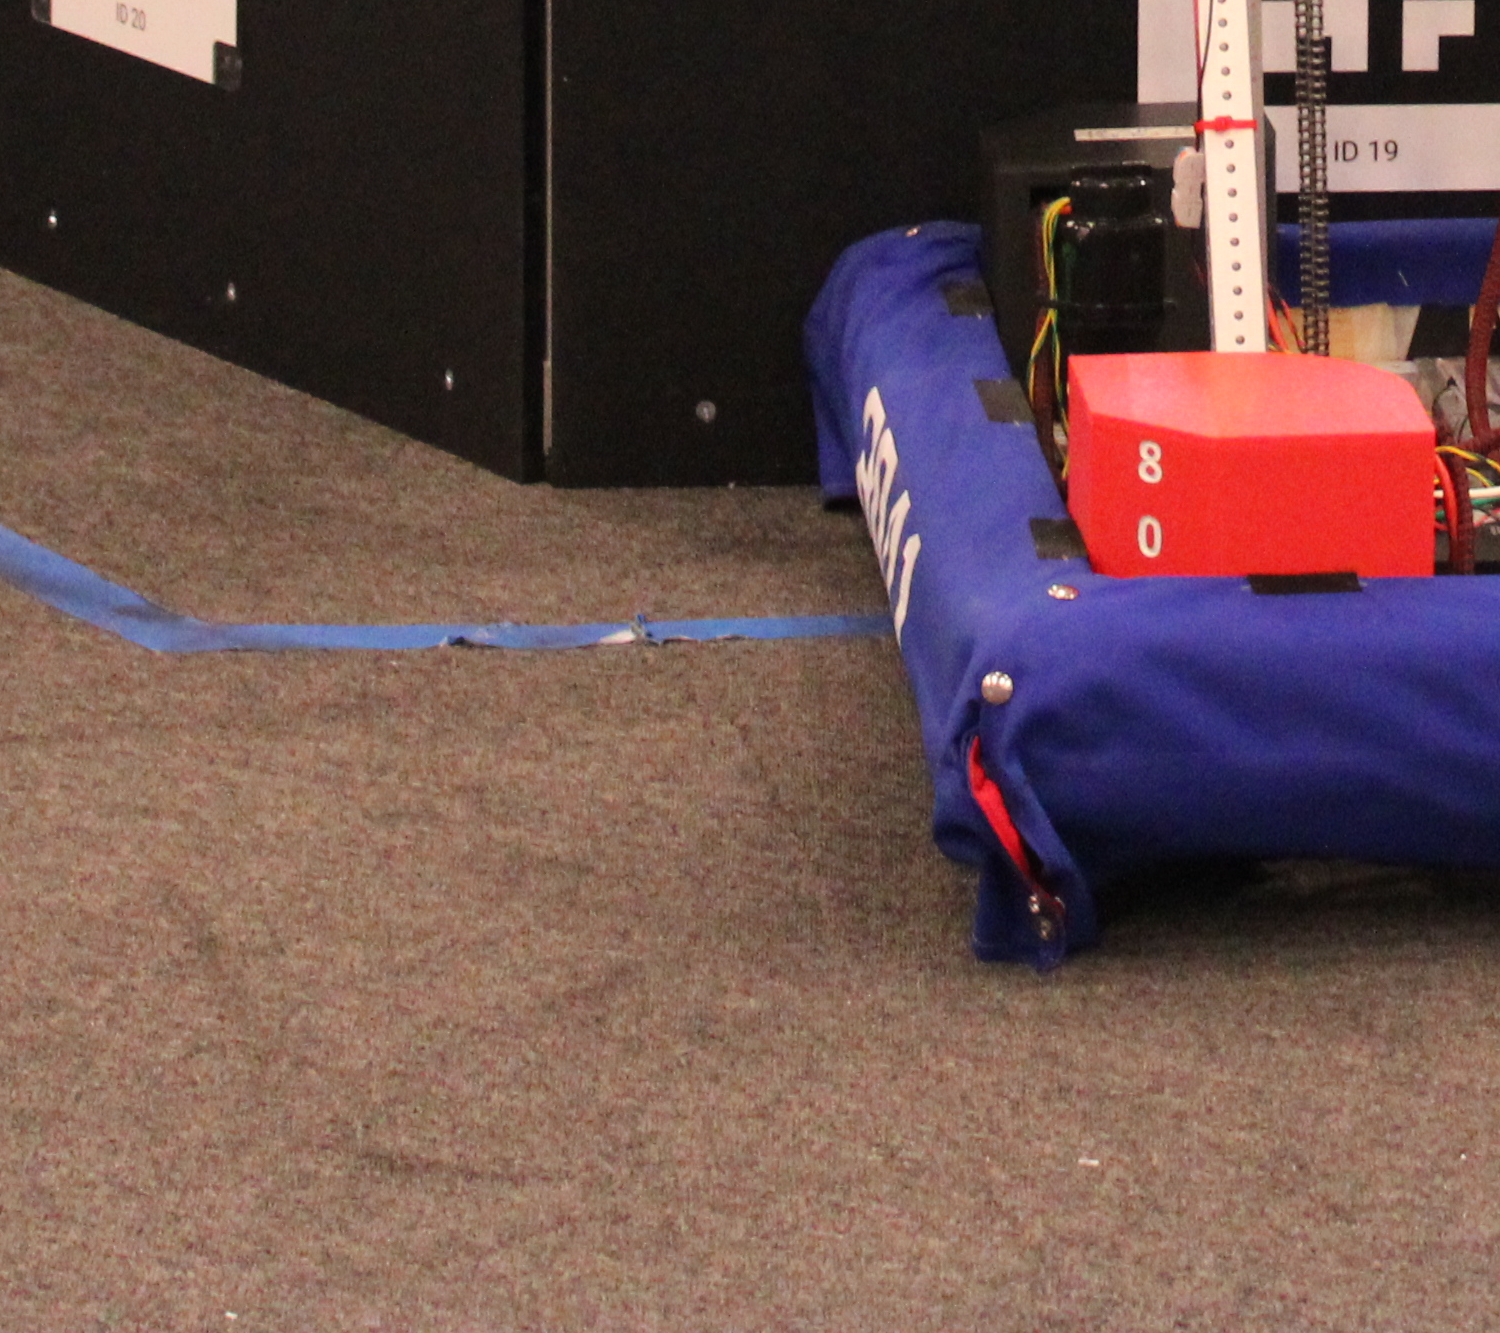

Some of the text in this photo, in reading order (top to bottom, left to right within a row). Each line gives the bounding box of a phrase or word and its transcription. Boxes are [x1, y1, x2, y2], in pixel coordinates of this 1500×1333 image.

[116, 1, 147, 32] ID 20
[1334, 139, 1398, 162] ID 19
